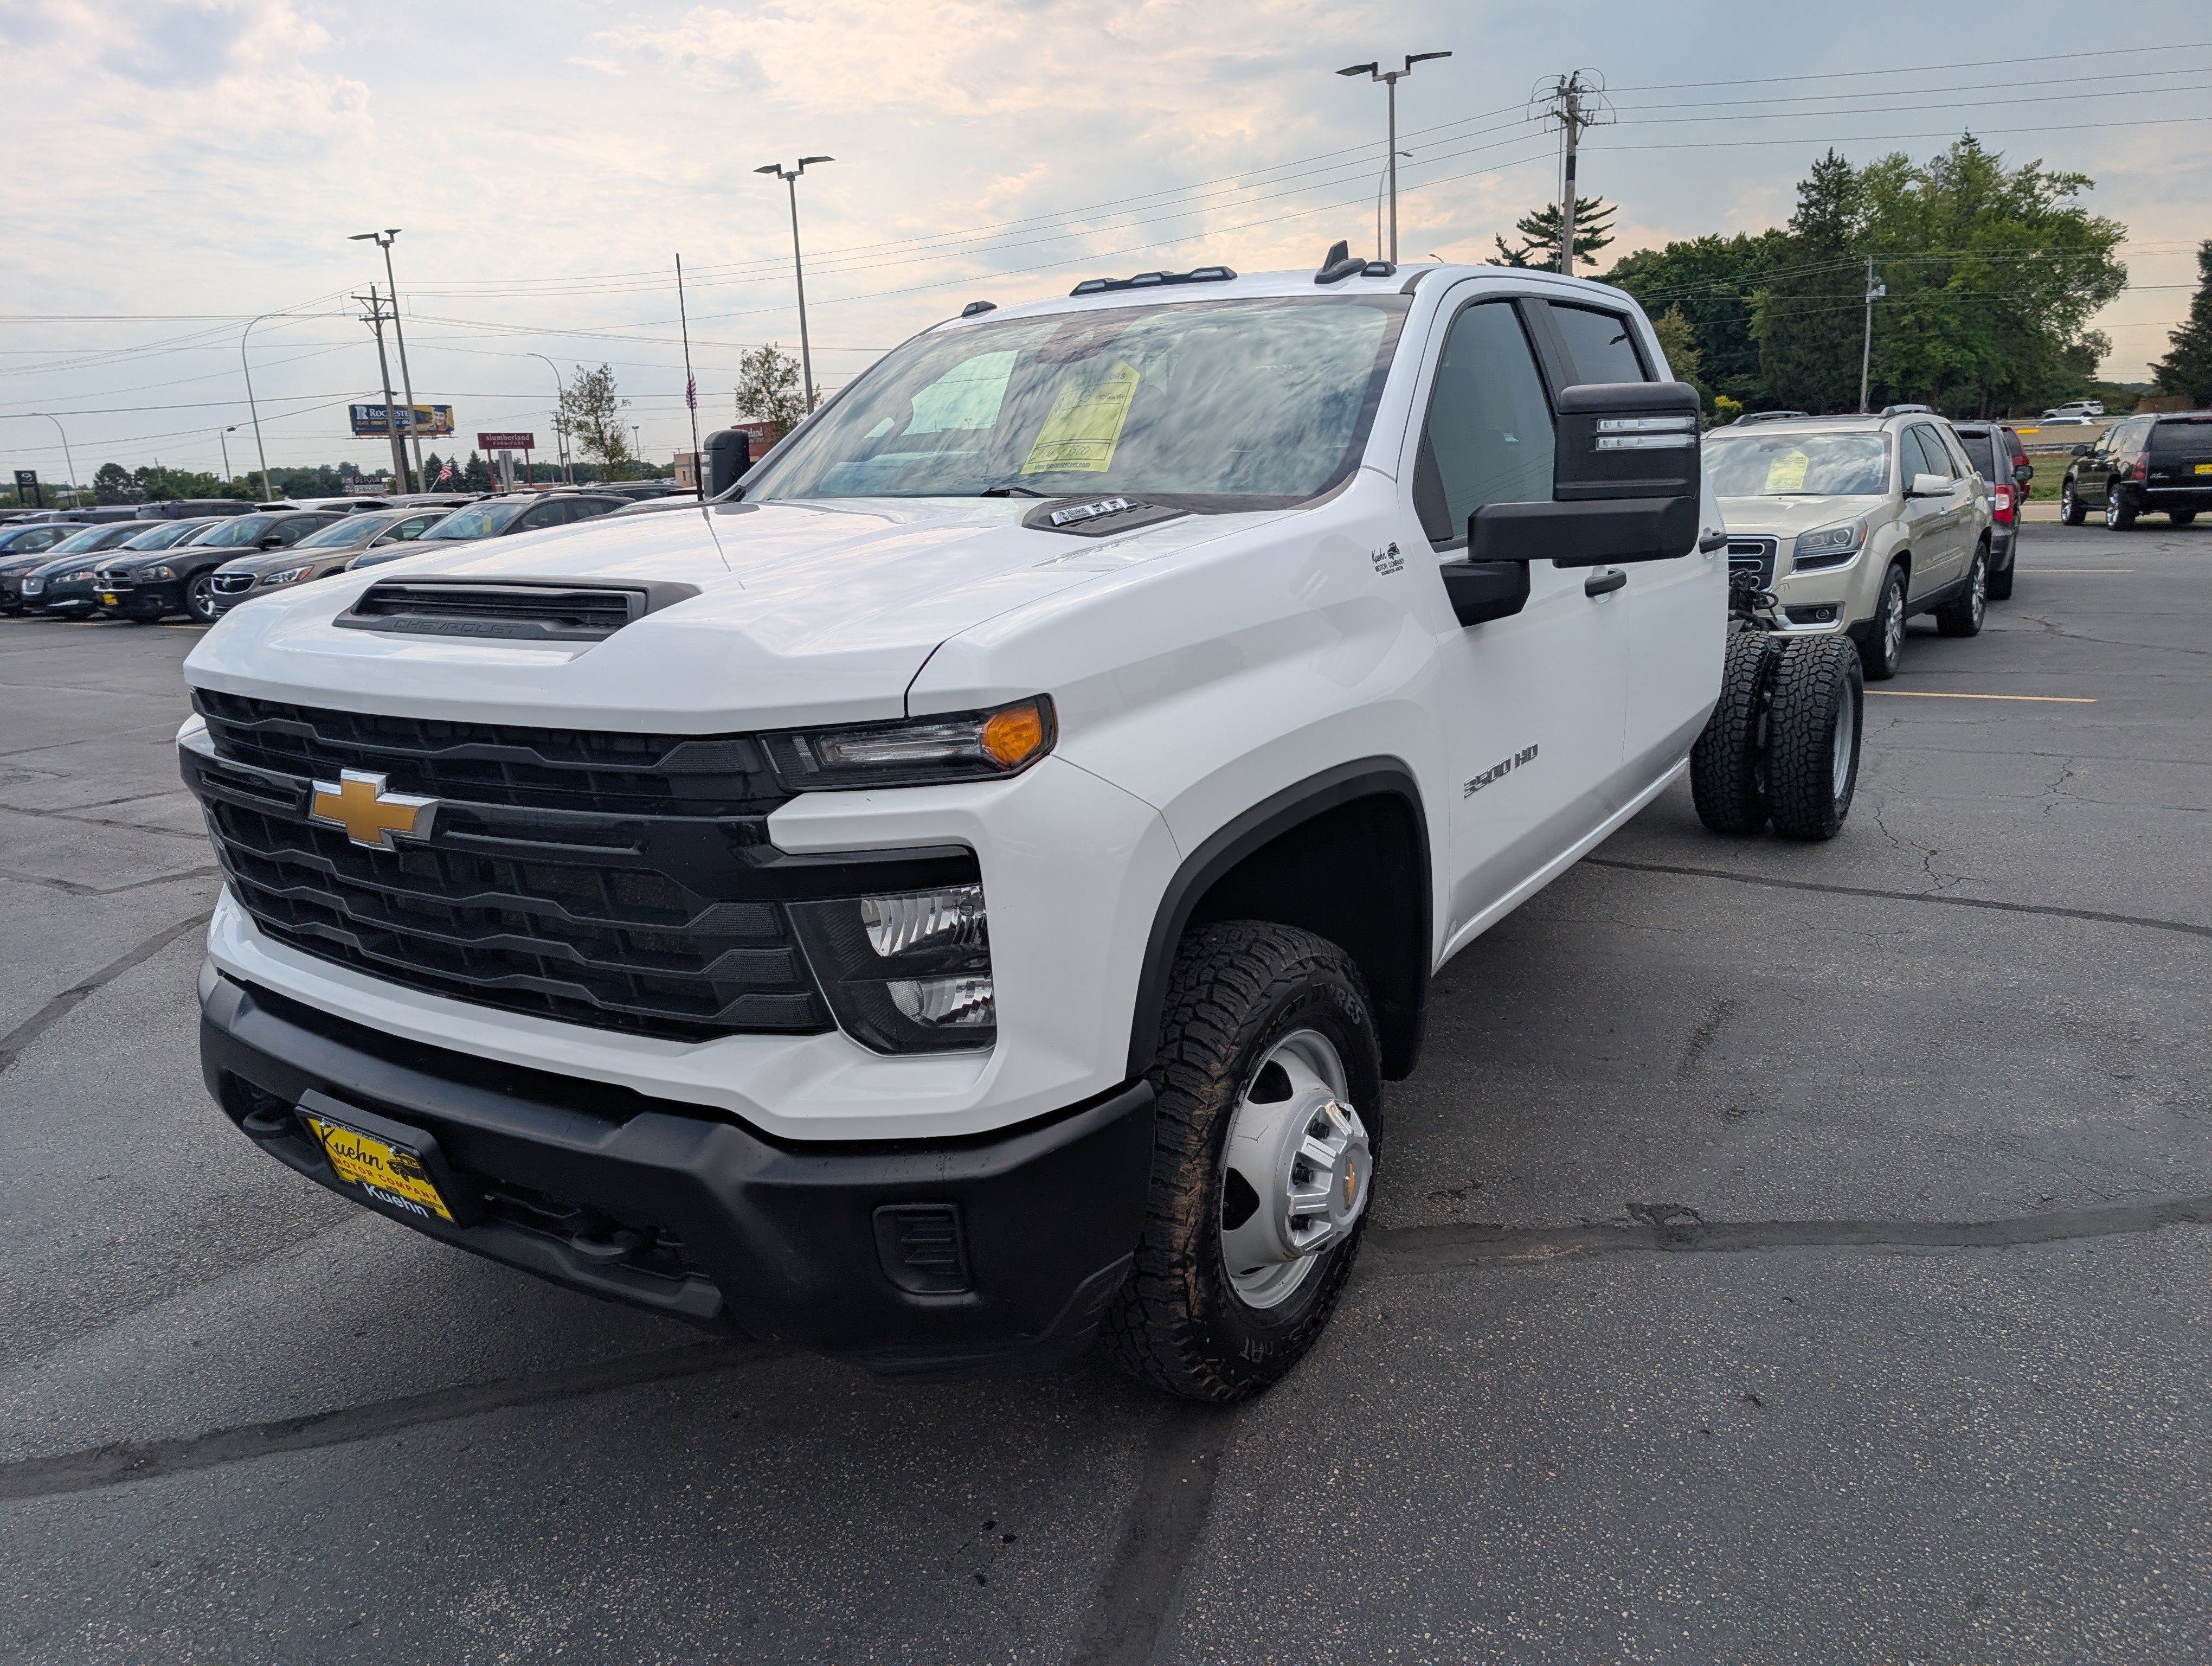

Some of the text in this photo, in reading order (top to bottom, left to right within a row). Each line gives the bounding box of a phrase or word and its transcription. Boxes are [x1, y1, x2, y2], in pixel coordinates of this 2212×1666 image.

[1066, 507, 1086, 518] Allison
[393, 618, 522, 636] CHEVROLET
[1463, 742, 1539, 799] 3500 HD
[320, 1127, 383, 1171] Kuehn
[333, 1156, 439, 1202] MOTOR COMPANY
[363, 1182, 430, 1219] Kuehn
